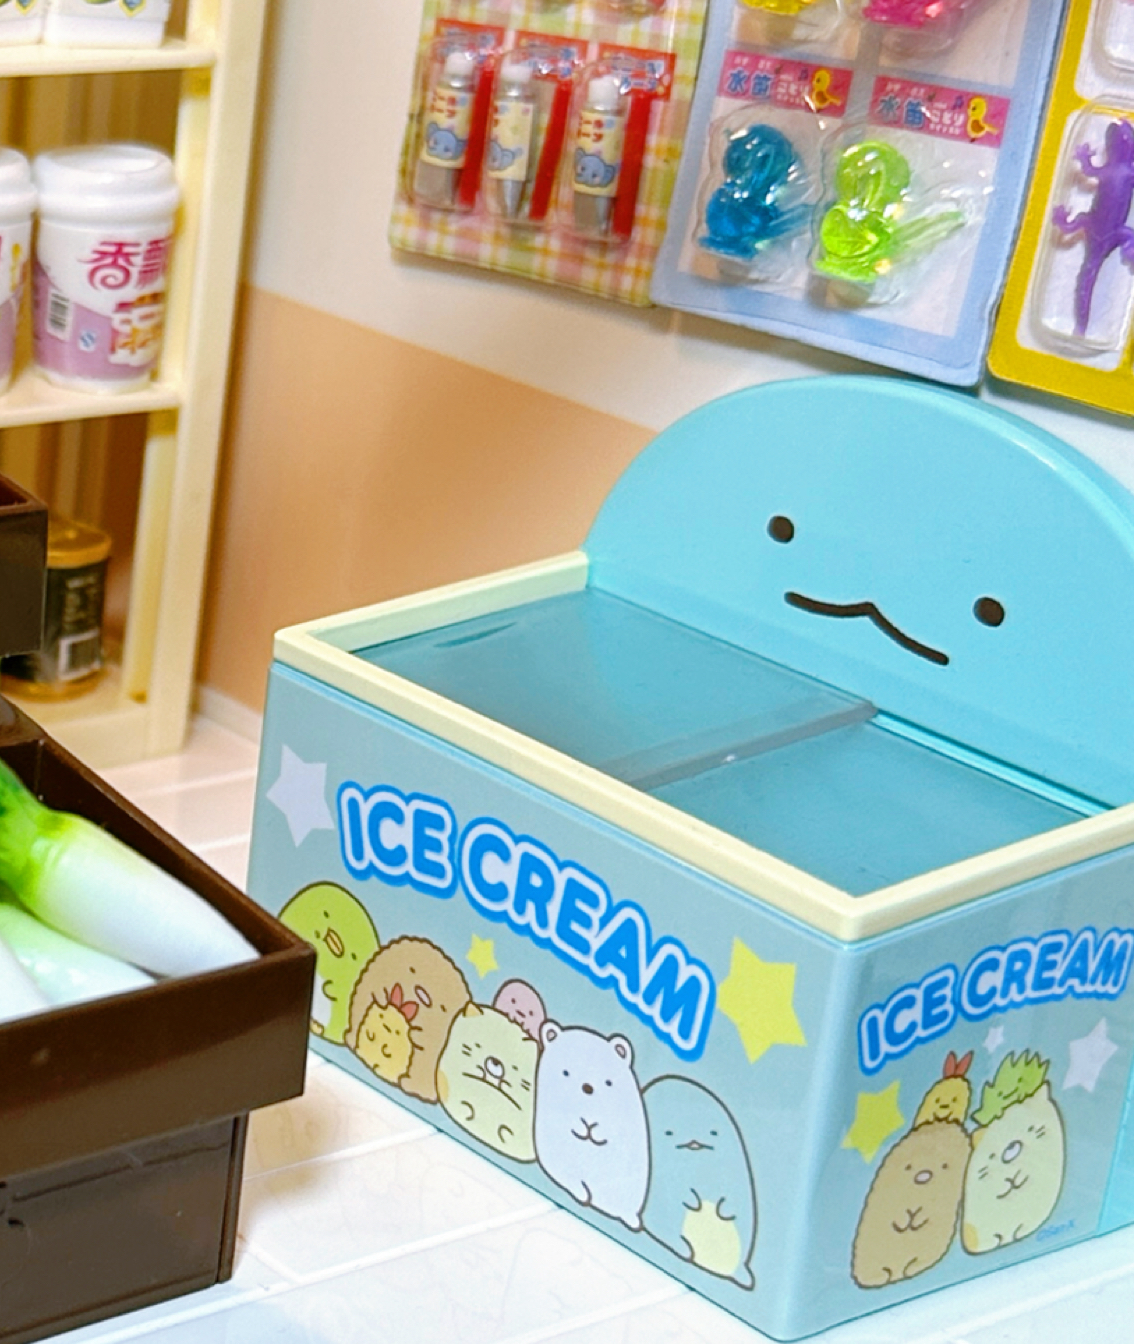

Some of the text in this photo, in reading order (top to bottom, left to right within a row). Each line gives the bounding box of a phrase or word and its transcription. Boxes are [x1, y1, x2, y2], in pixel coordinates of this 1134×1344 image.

[726, 68, 774, 97] 水笛
[875, 94, 926, 130] 水笛
[338, 782, 716, 1060] ICE CREAM
[858, 927, 1134, 1075] ICE CREAM
